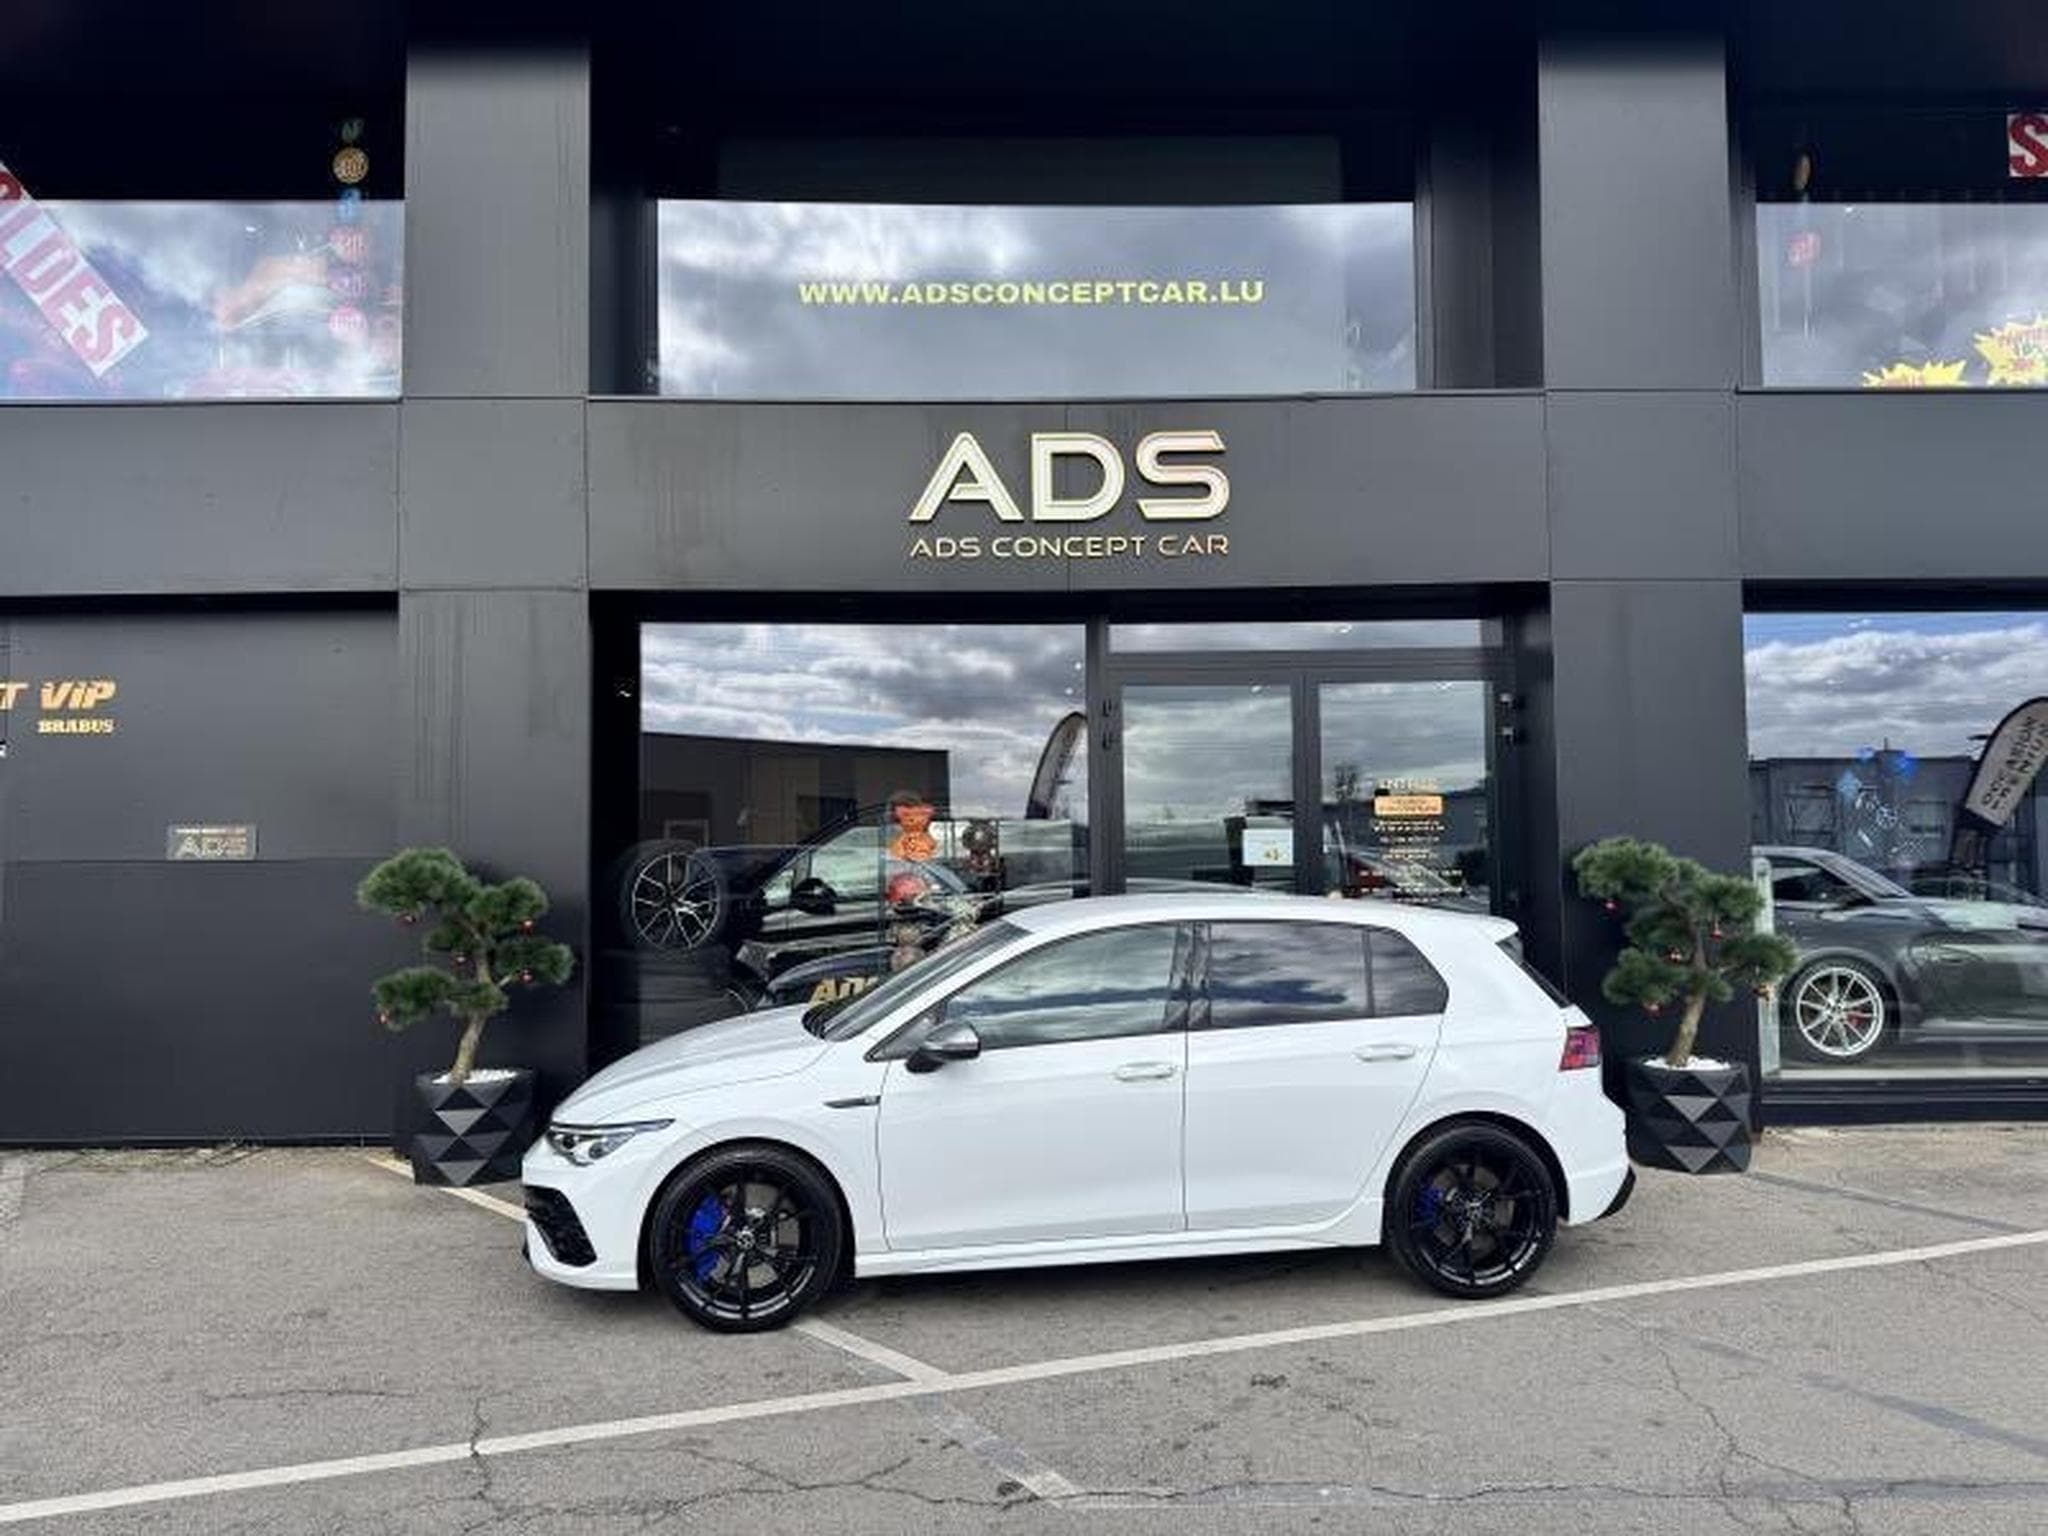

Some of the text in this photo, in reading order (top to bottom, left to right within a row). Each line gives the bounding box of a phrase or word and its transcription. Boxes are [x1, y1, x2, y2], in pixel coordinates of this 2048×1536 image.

[799, 280, 1264, 305] WWW.ADSCONCEPTCAR.LU
[909, 430, 1231, 522] ADS
[910, 534, 1229, 558] ADS CONCEPT CAR
[38, 718, 114, 734] BRABUS
